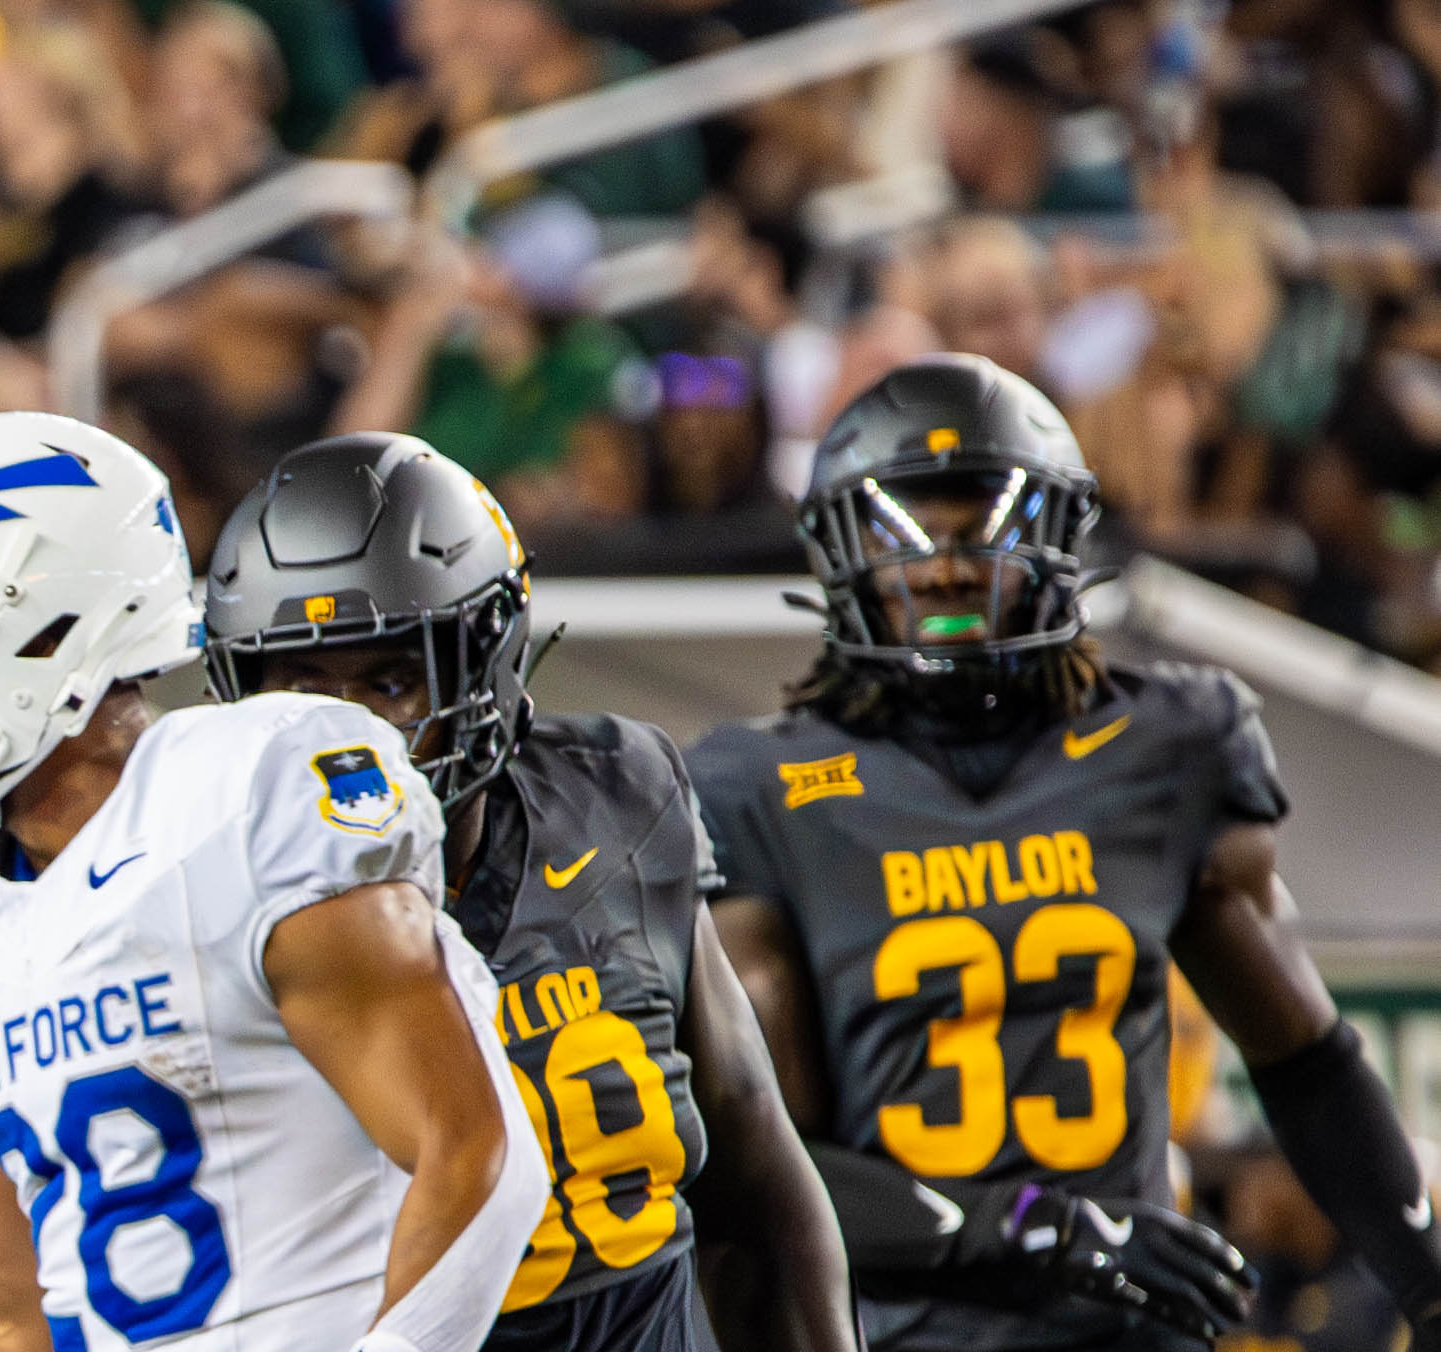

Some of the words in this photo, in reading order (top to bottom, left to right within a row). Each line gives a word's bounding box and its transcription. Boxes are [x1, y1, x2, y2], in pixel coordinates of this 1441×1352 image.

[880, 830, 1098, 918] BAYLOR
[2, 971, 183, 1086] FORCE
[873, 903, 1136, 1178] 33
